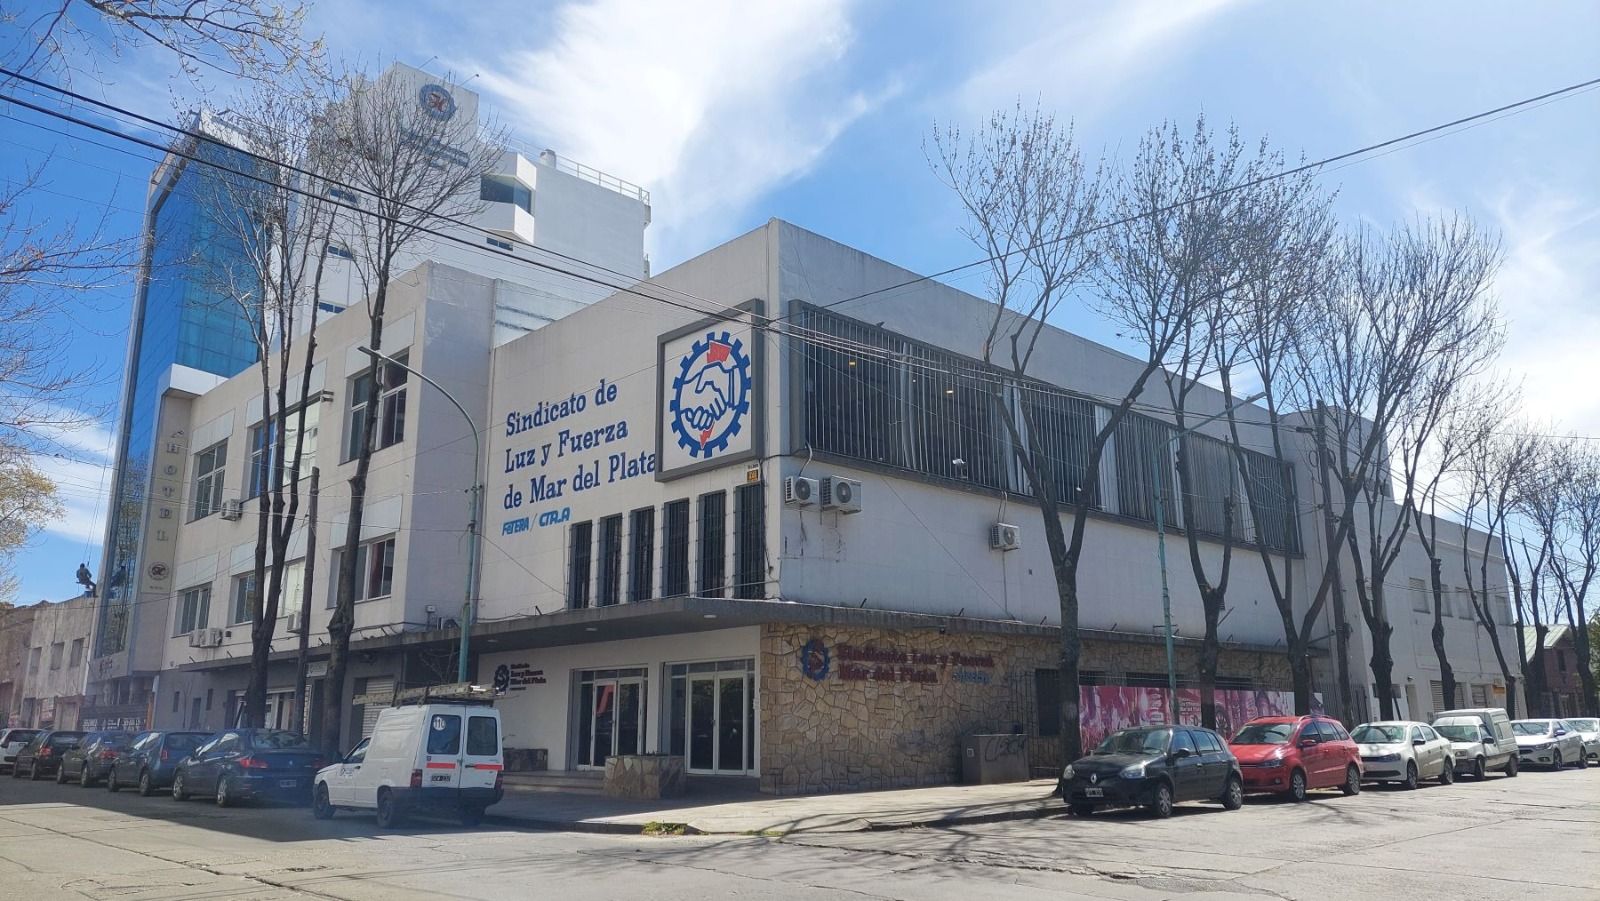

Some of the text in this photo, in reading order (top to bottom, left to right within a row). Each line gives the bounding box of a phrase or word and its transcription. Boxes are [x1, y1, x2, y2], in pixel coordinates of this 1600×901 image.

[505, 378, 618, 438] Sindicato de
[504, 420, 629, 474] Luz y Fuerza
[503, 450, 656, 510] de Mar del Plata
